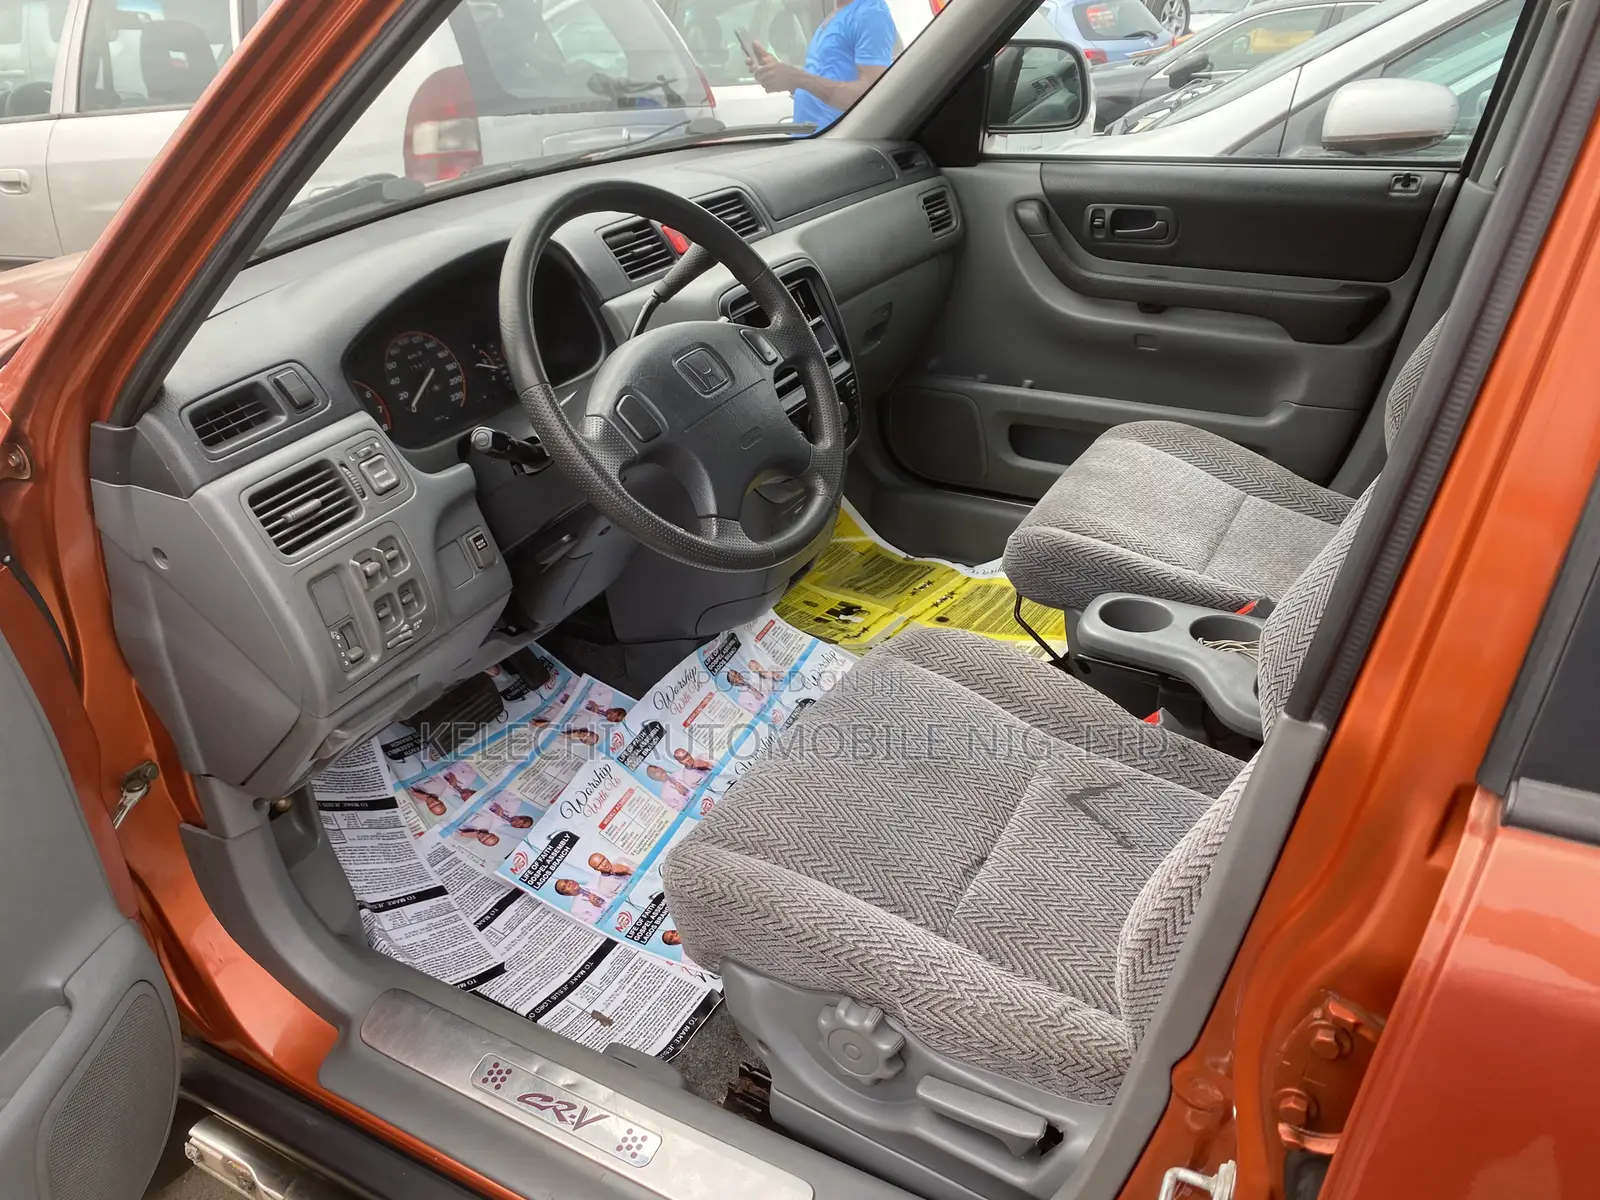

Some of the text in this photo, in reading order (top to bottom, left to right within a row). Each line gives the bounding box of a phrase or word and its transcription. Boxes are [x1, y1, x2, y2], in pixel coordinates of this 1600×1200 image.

[653, 666, 697, 710] Worship
[560, 763, 613, 819] Worship
[527, 833, 571, 885] GOSPEL ASSEMBLY
[538, 845, 554, 862] FAITH
[533, 846, 571, 889] LAGOS BRANCH
[642, 903, 657, 919] FAITH
[634, 919, 654, 941] GOSPEL
[640, 925, 657, 944] LAGOS
[570, 970, 586, 985] MAKE
[551, 984, 569, 1000] JESUS
[535, 999, 552, 1013] LORD
[673, 1025, 691, 1045] MAKE
[517, 1092, 611, 1131] CR-V
